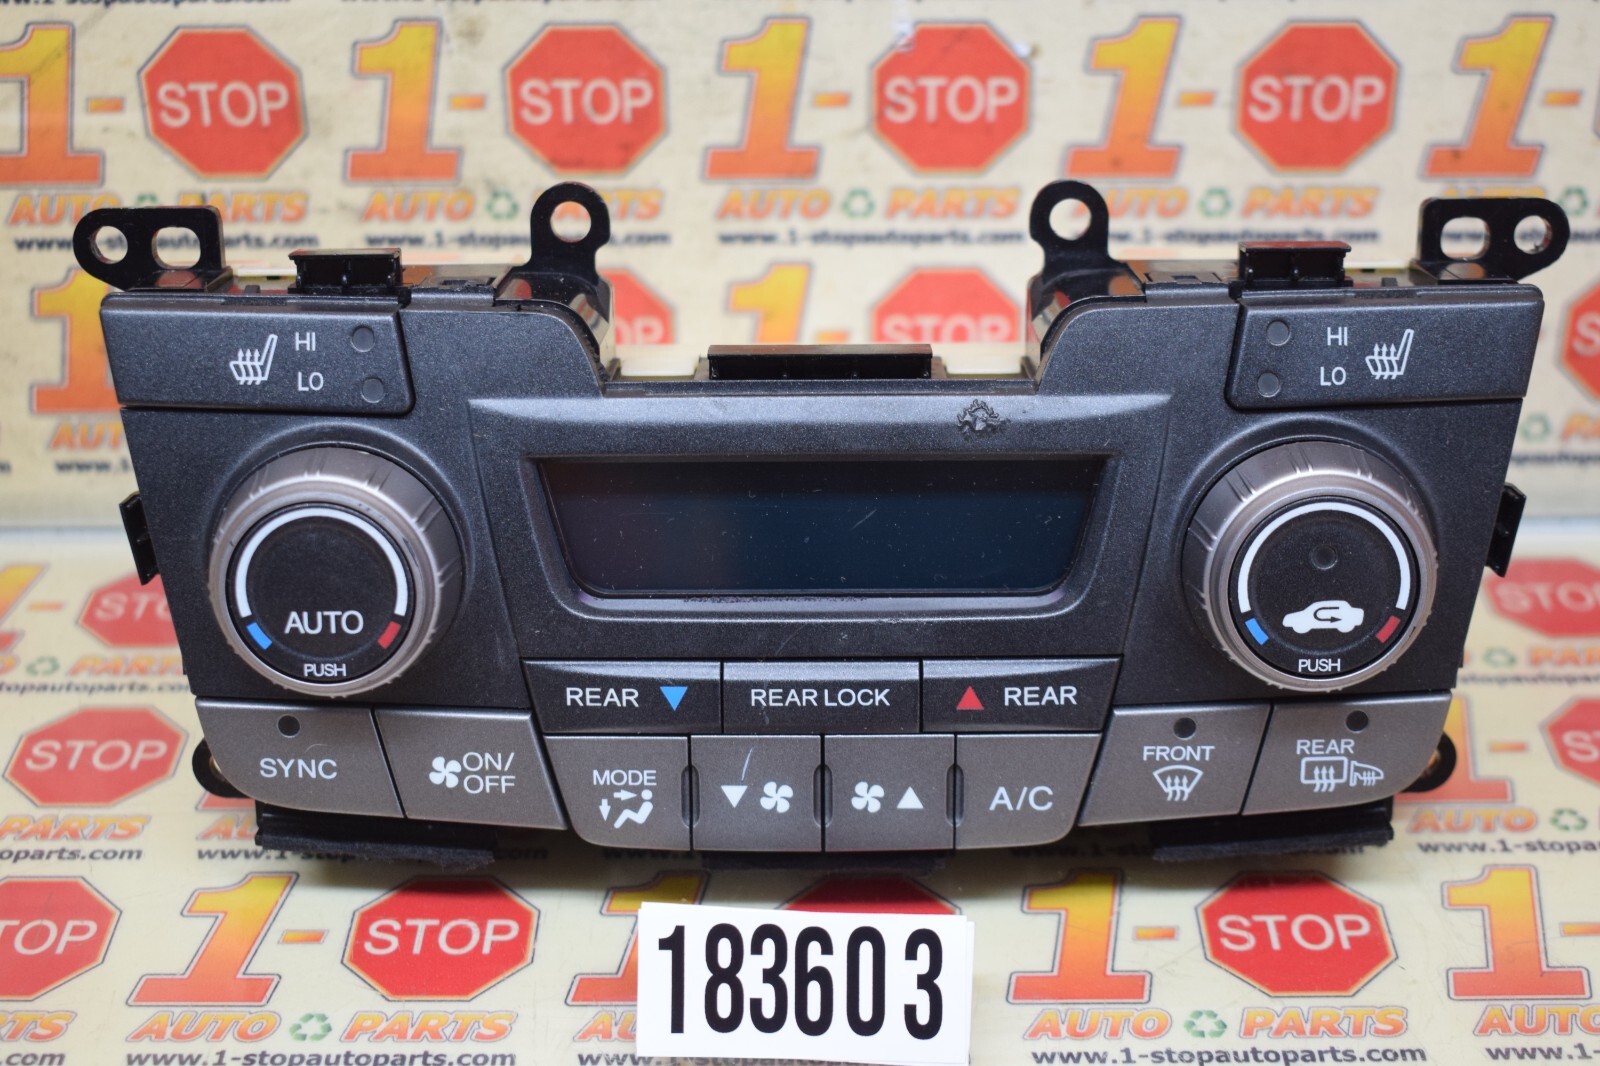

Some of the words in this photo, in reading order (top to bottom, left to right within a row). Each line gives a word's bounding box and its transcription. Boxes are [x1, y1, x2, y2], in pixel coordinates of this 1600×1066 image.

[156, 81, 290, 128] STOP
[519, 78, 654, 125] STOP
[883, 76, 1020, 124] STOP
[1247, 75, 1387, 123] STOP
[361, 189, 476, 222] AUTO
[715, 187, 832, 220] AUTO
[884, 186, 1022, 220] PARTS
[1240, 186, 1379, 219] PARTS
[294, 332, 317, 352] HI
[1326, 326, 1349, 347] HI
[297, 371, 325, 392] LO
[1319, 366, 1347, 386] LO
[51, 420, 127, 450] AUT
[96, 591, 172, 622] ST
[284, 610, 364, 635] AUTO
[303, 662, 347, 678] PUSH
[1298, 657, 1342, 673] PUSH
[564, 686, 640, 708] REAR
[750, 688, 819, 708] REAR
[823, 687, 892, 708] LOCK
[1003, 685, 1078, 706] REAR
[25, 740, 168, 771] STOP
[1143, 745, 1216, 762] FRONT
[1296, 739, 1356, 755] REAR
[259, 757, 338, 780] SYNC
[462, 751, 515, 773] ON/
[463, 775, 517, 795] OFF
[592, 769, 658, 788] MODE
[989, 785, 1054, 811] A/C
[0, 815, 150, 841] PARTS
[1408, 808, 1538, 833] AUTO
[363, 918, 520, 956] STOP
[1217, 914, 1371, 951] STOP
[658, 922, 943, 1040] 183603
[126, 1011, 281, 1042] AUTO
[340, 1010, 518, 1042] PARTS
[1023, 1007, 1172, 1040] AUTO
[1239, 1005, 1408, 1038] PARTS
[1032, 1046, 1427, 1066] www.1-stopautoparts.com
